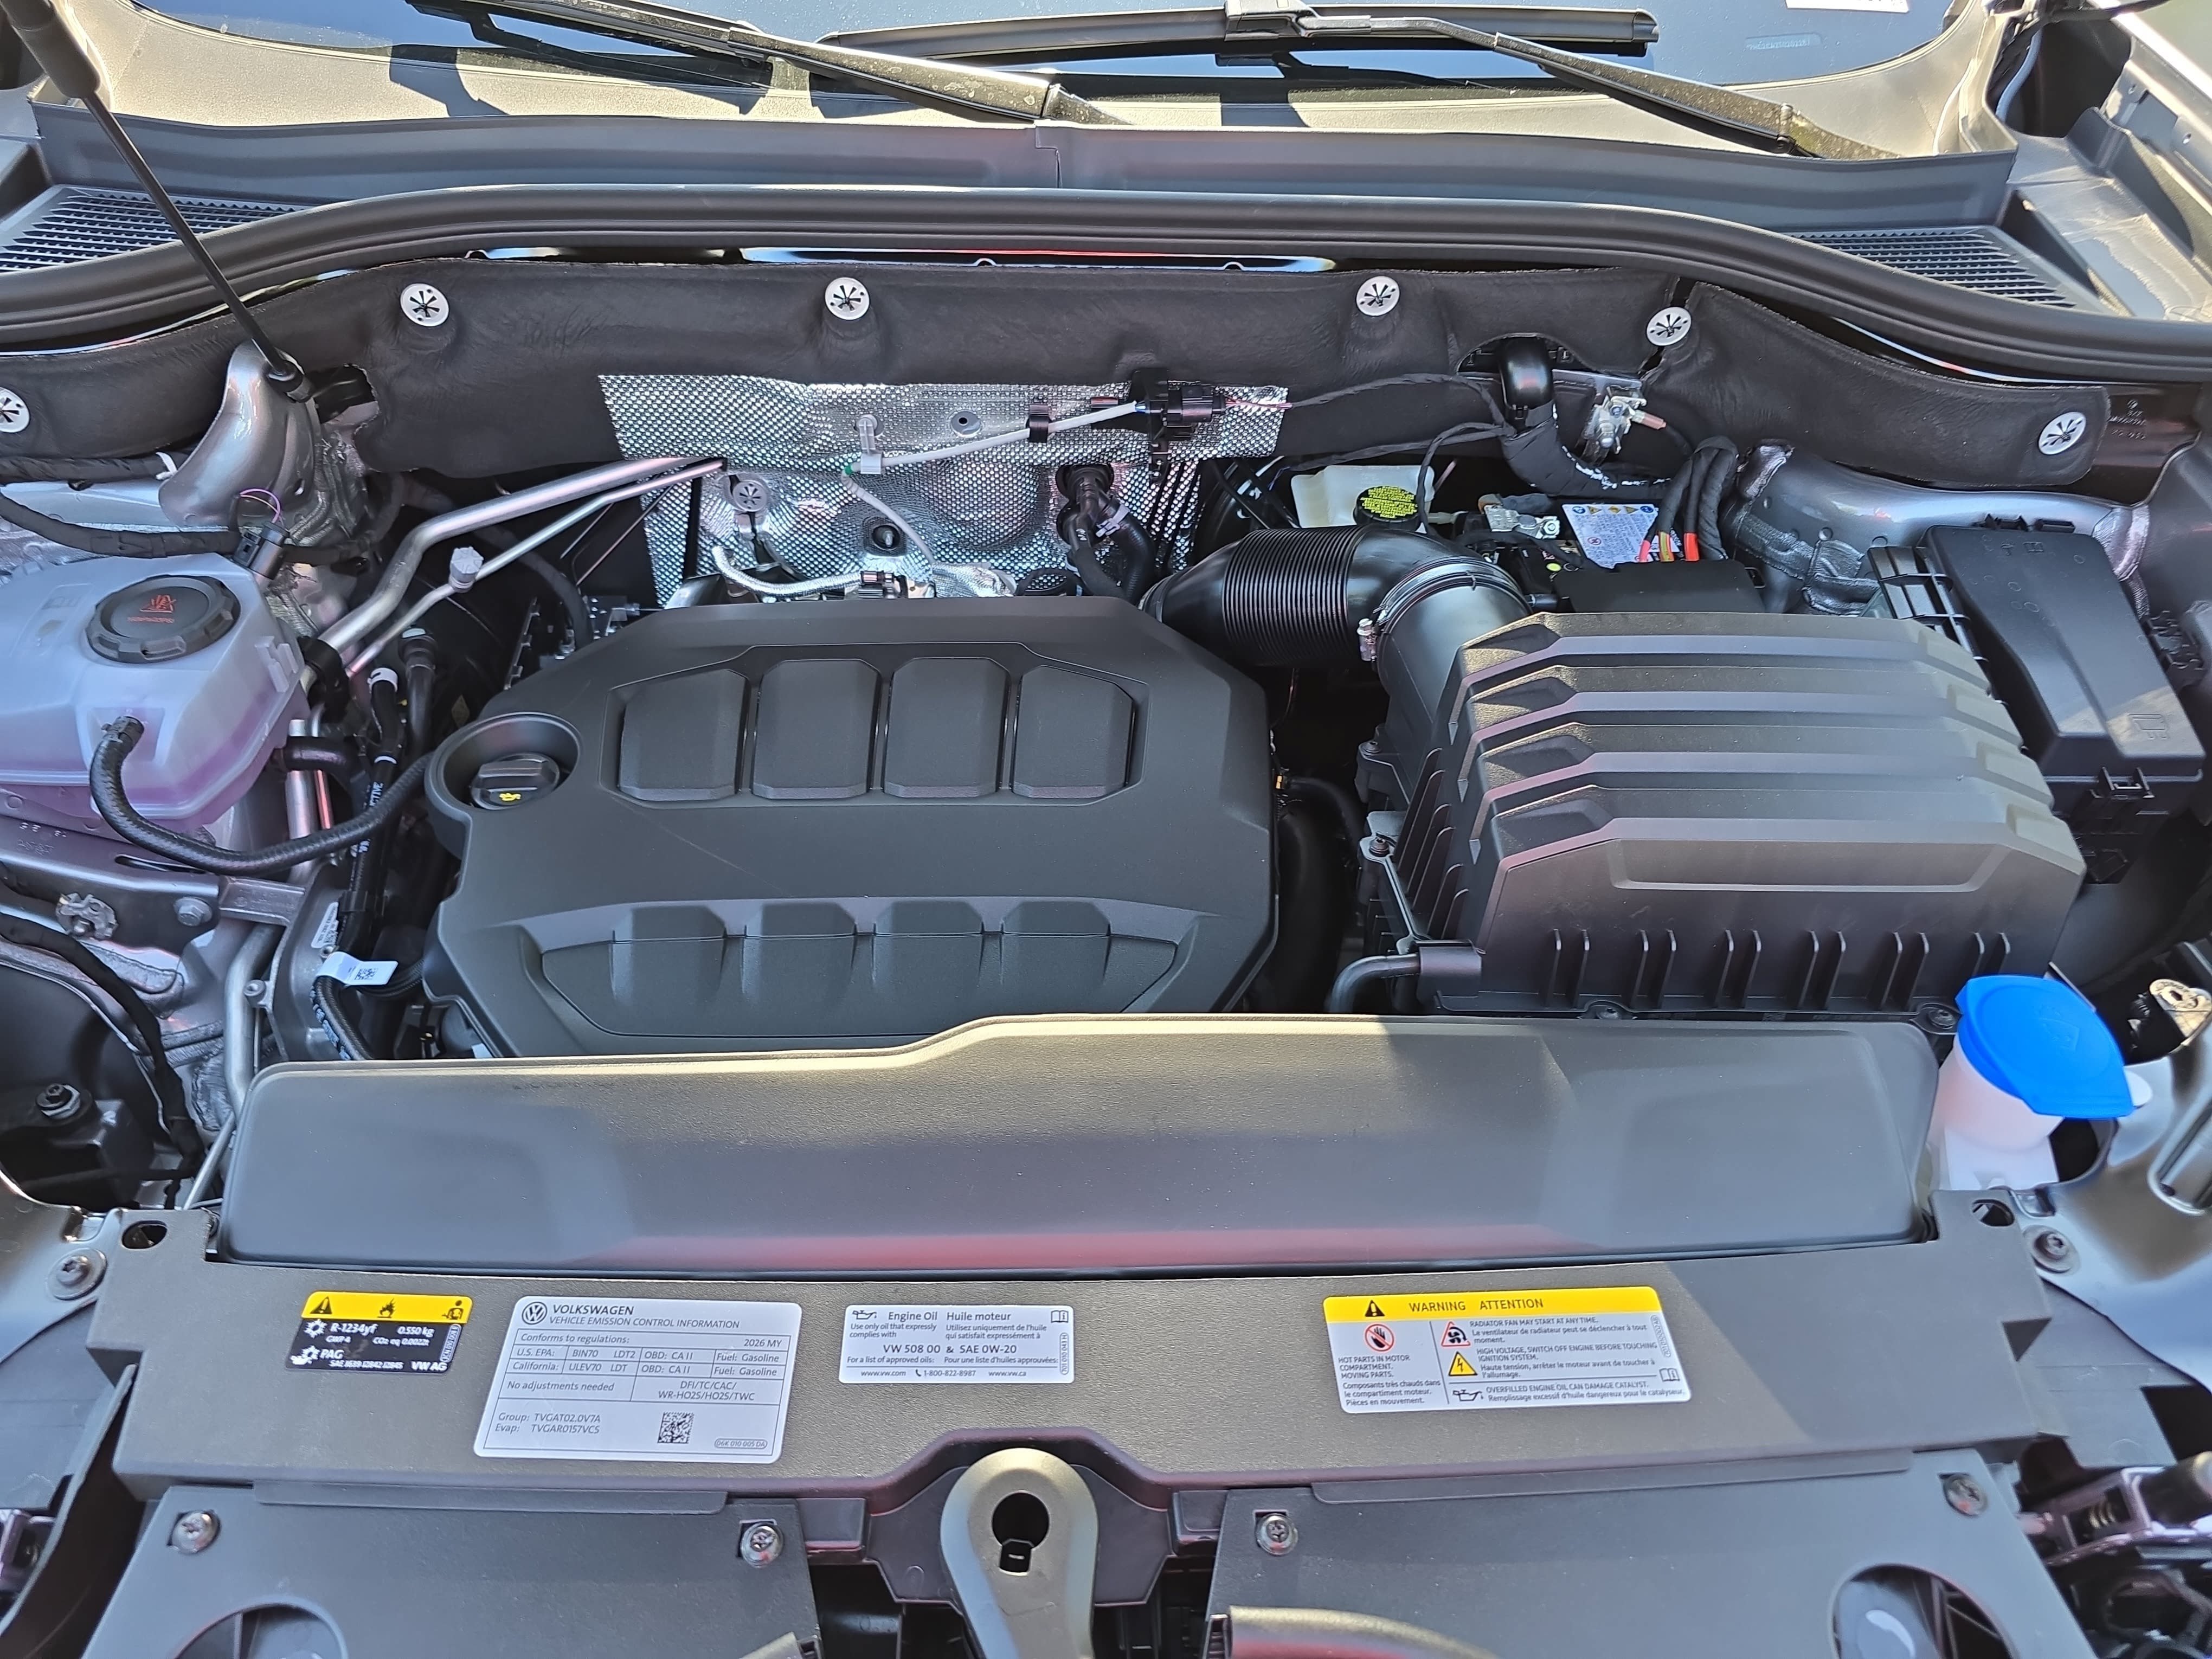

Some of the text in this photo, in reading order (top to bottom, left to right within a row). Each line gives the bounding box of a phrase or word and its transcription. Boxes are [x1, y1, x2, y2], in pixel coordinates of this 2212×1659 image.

[552, 1304, 634, 1315] VOLKSWAGEN
[1409, 1298, 1544, 1312] WARNING ATTENTION
[888, 1311, 937, 1322] Engine Oil
[946, 1312, 1011, 1321] Huile moteur
[549, 1316, 740, 1328] VEHICLE EMISSION CONTROL INFORMATION
[330, 1323, 435, 1338] R-1234yf 0.550 kg
[864, 1323, 879, 1332] only
[905, 1323, 937, 1332] expressly
[973, 1324, 1015, 1333] uniquement
[520, 1333, 564, 1342] Conforms
[576, 1334, 630, 1345] regulations:
[850, 1331, 880, 1339] complies
[987, 1332, 1034, 1340] expressément
[743, 1338, 782, 1347] 2026 MY
[517, 1348, 555, 1356] U.S. EPA:
[883, 1344, 902, 1353] VW
[904, 1344, 924, 1353] 508
[926, 1344, 941, 1353] 00
[960, 1345, 979, 1353] SAE
[981, 1345, 1017, 1353] 0W-20
[1494, 1346, 1527, 1354] VOLTAGE,
[319, 1349, 345, 1359] PAG
[572, 1349, 636, 1359] BIN70 LDT2
[644, 1351, 687, 1360] OBD: CA
[716, 1352, 779, 1362] Fuel: Gasoline
[886, 1356, 919, 1365] approved
[1017, 1356, 1058, 1365] approuvées:
[410, 1361, 448, 1372] VW AG
[512, 1361, 559, 1371] California:
[569, 1362, 628, 1372] ULEV70 LDT
[641, 1364, 684, 1373] OBD: CA
[1339, 1363, 1393, 1371] COMPARTMENT.
[713, 1366, 777, 1376] Fuel: Gasoline
[507, 1381, 614, 1392] No adjustments needed
[680, 1380, 738, 1390] DFI/TC/CAC/
[1343, 1381, 1384, 1390] Composants
[1486, 1385, 1528, 1393] OVERFILLED
[658, 1391, 755, 1401] WR-HO2S/HO2S/TWC
[1352, 1390, 1403, 1398] compartiment
[1488, 1394, 1532, 1402] Remplissage
[498, 1412, 601, 1424] Group: TVGAT02.0V7A
[495, 1424, 520, 1435] Evap:
